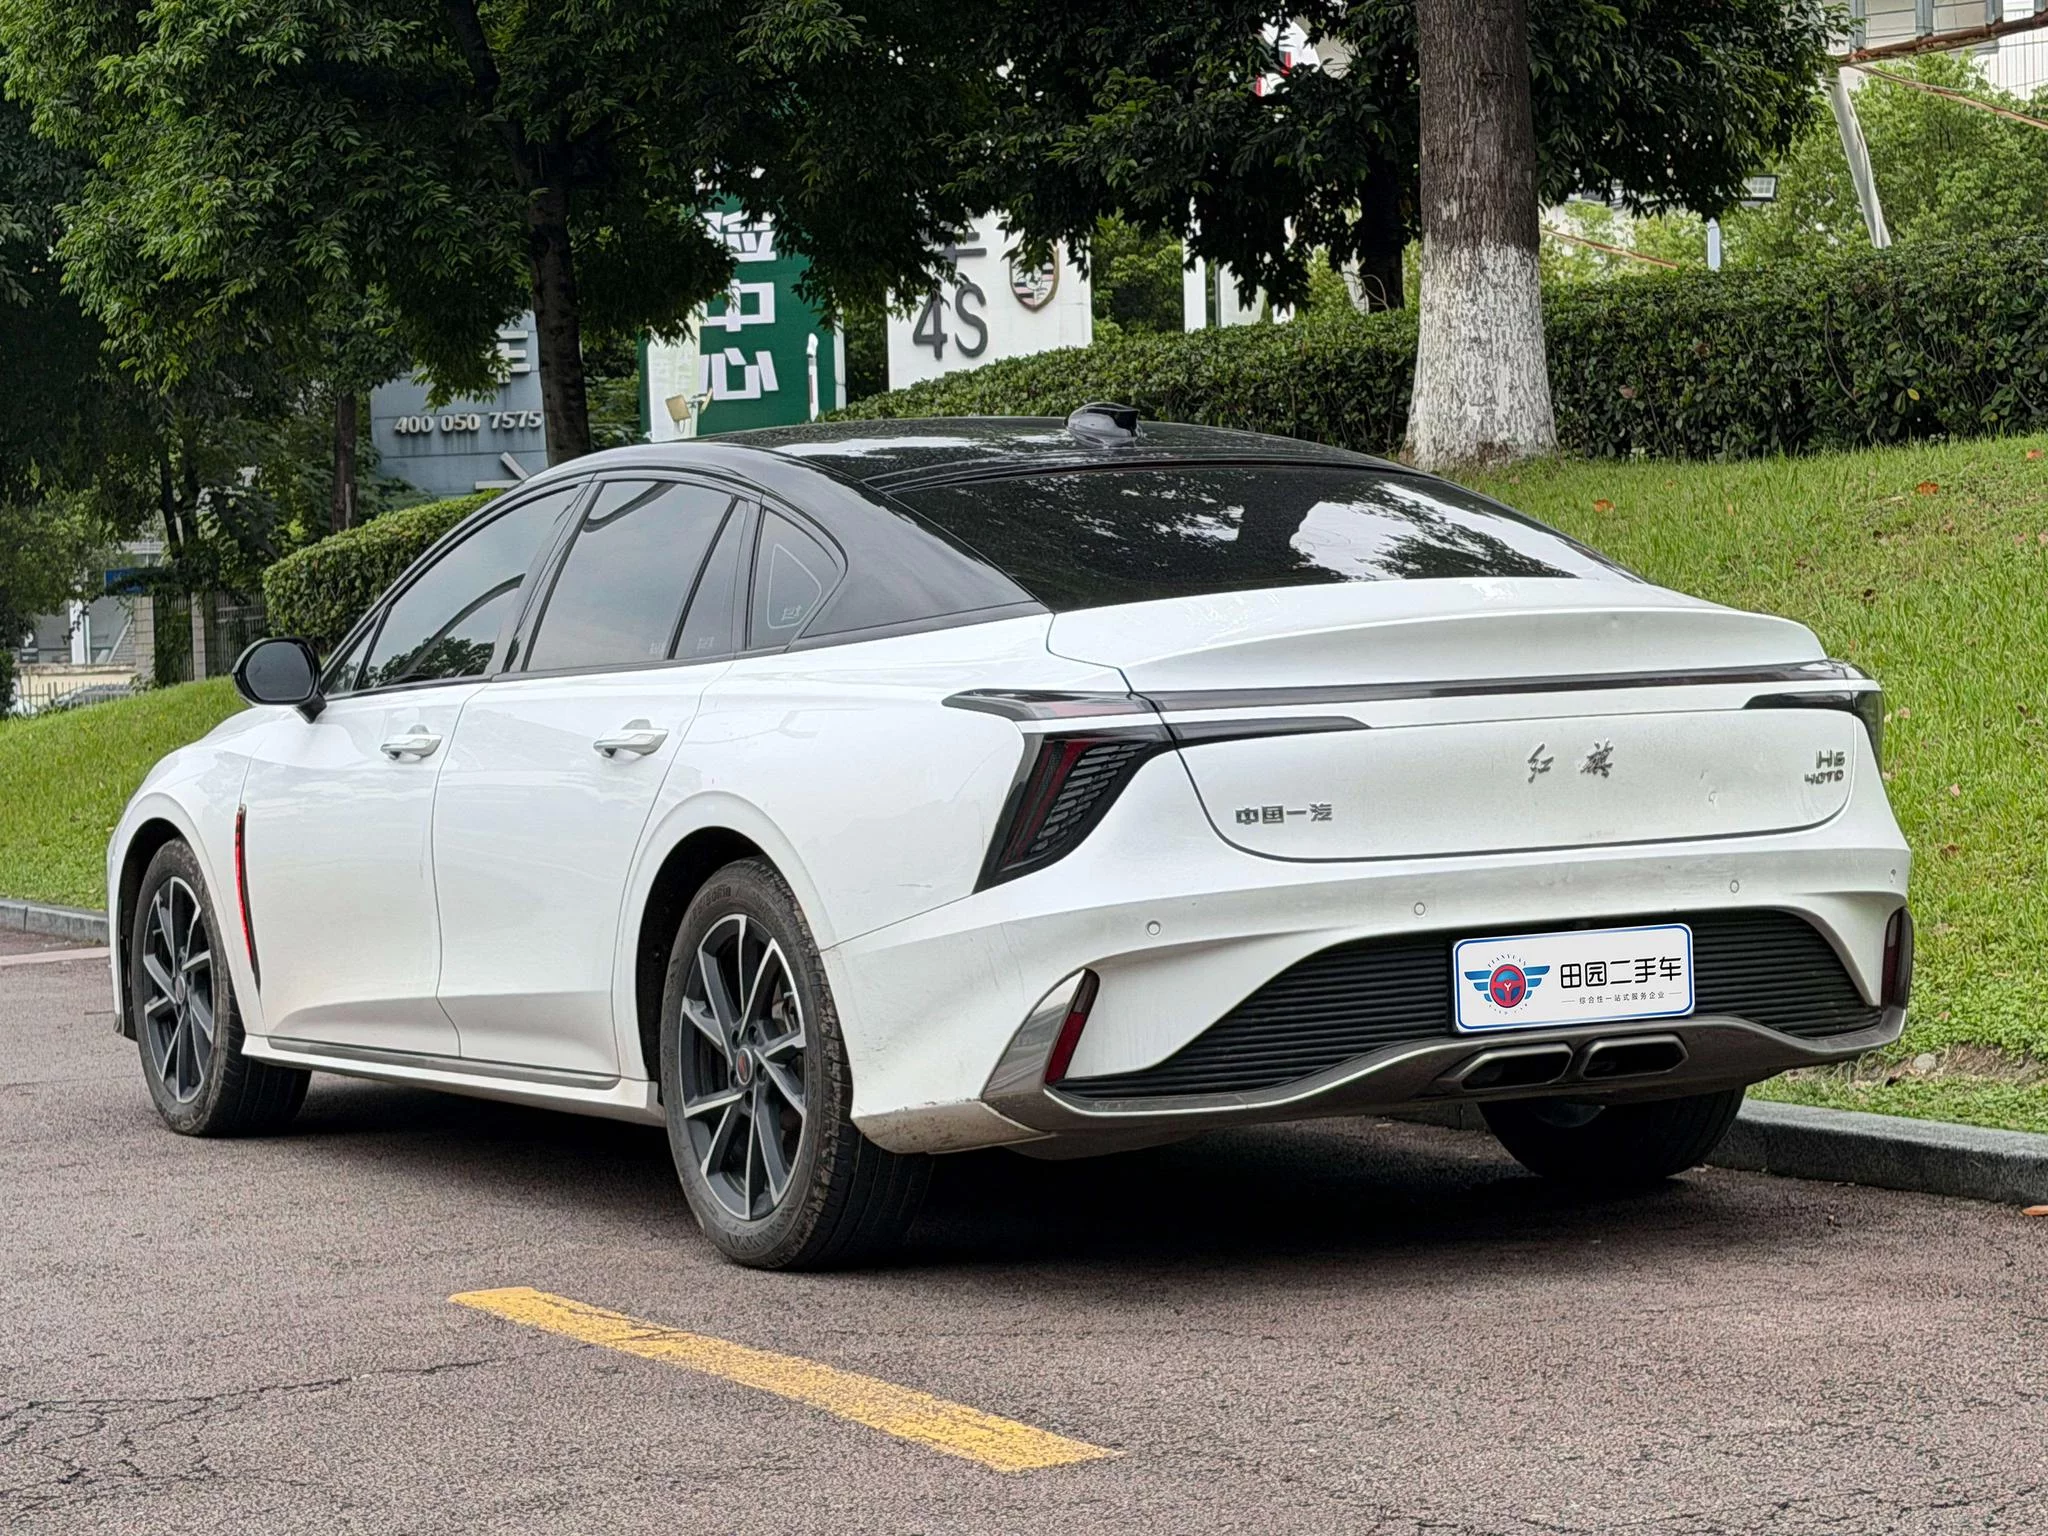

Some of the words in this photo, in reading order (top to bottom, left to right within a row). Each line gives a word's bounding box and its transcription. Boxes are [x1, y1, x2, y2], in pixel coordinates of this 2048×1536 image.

[912, 281, 988, 361] 4S
[394, 415, 434, 435] 400
[441, 413, 481, 432] 050
[488, 410, 543, 430] 7575
[1527, 738, 1614, 783] 红旗
[1235, 803, 1333, 825] 中国一汽
[1560, 956, 1682, 989] 田园二手车
[1578, 991, 1665, 1005] 综合性一站式服务企业
